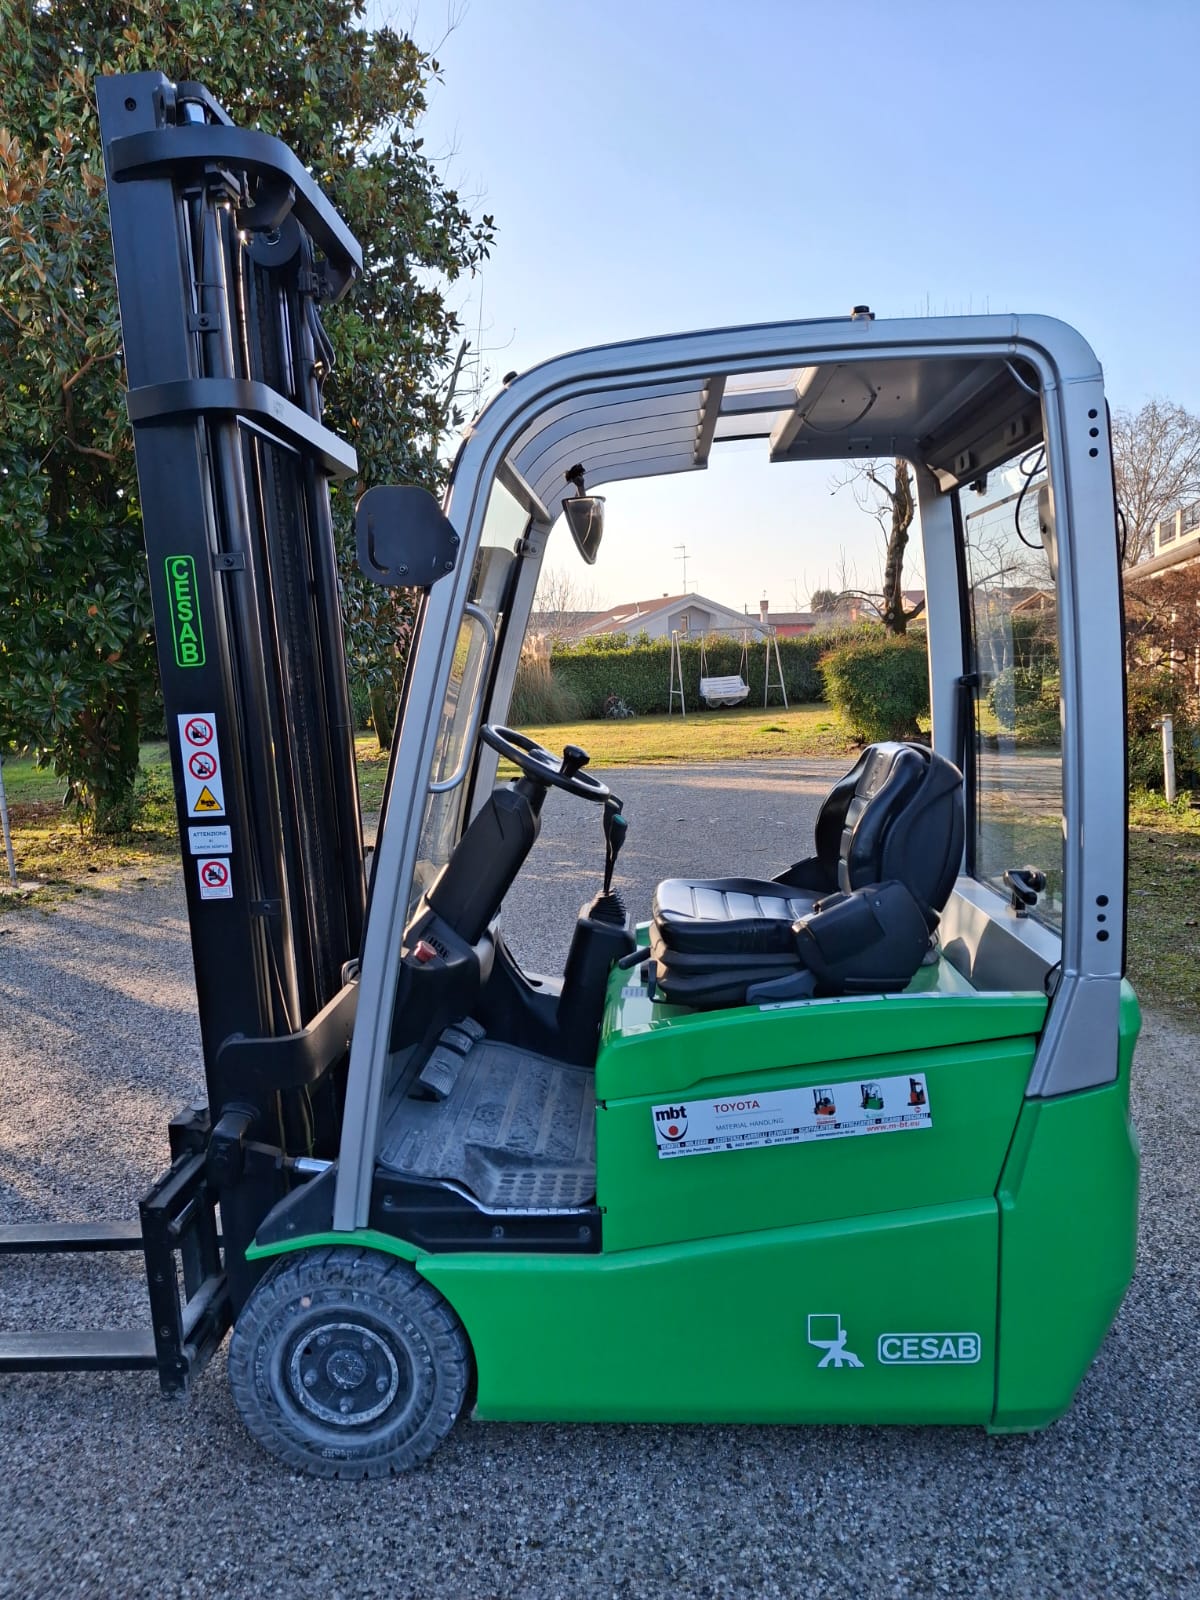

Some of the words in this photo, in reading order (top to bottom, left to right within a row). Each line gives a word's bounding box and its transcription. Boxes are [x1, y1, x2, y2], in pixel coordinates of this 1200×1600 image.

[171, 559, 199, 663] CESAB
[655, 1106, 687, 1121] mbt
[713, 1100, 760, 1113] TOYOTA
[715, 1122, 748, 1131] MATERIAL
[749, 1118, 784, 1127] HANDLING
[882, 1338, 977, 1359] CESAB
